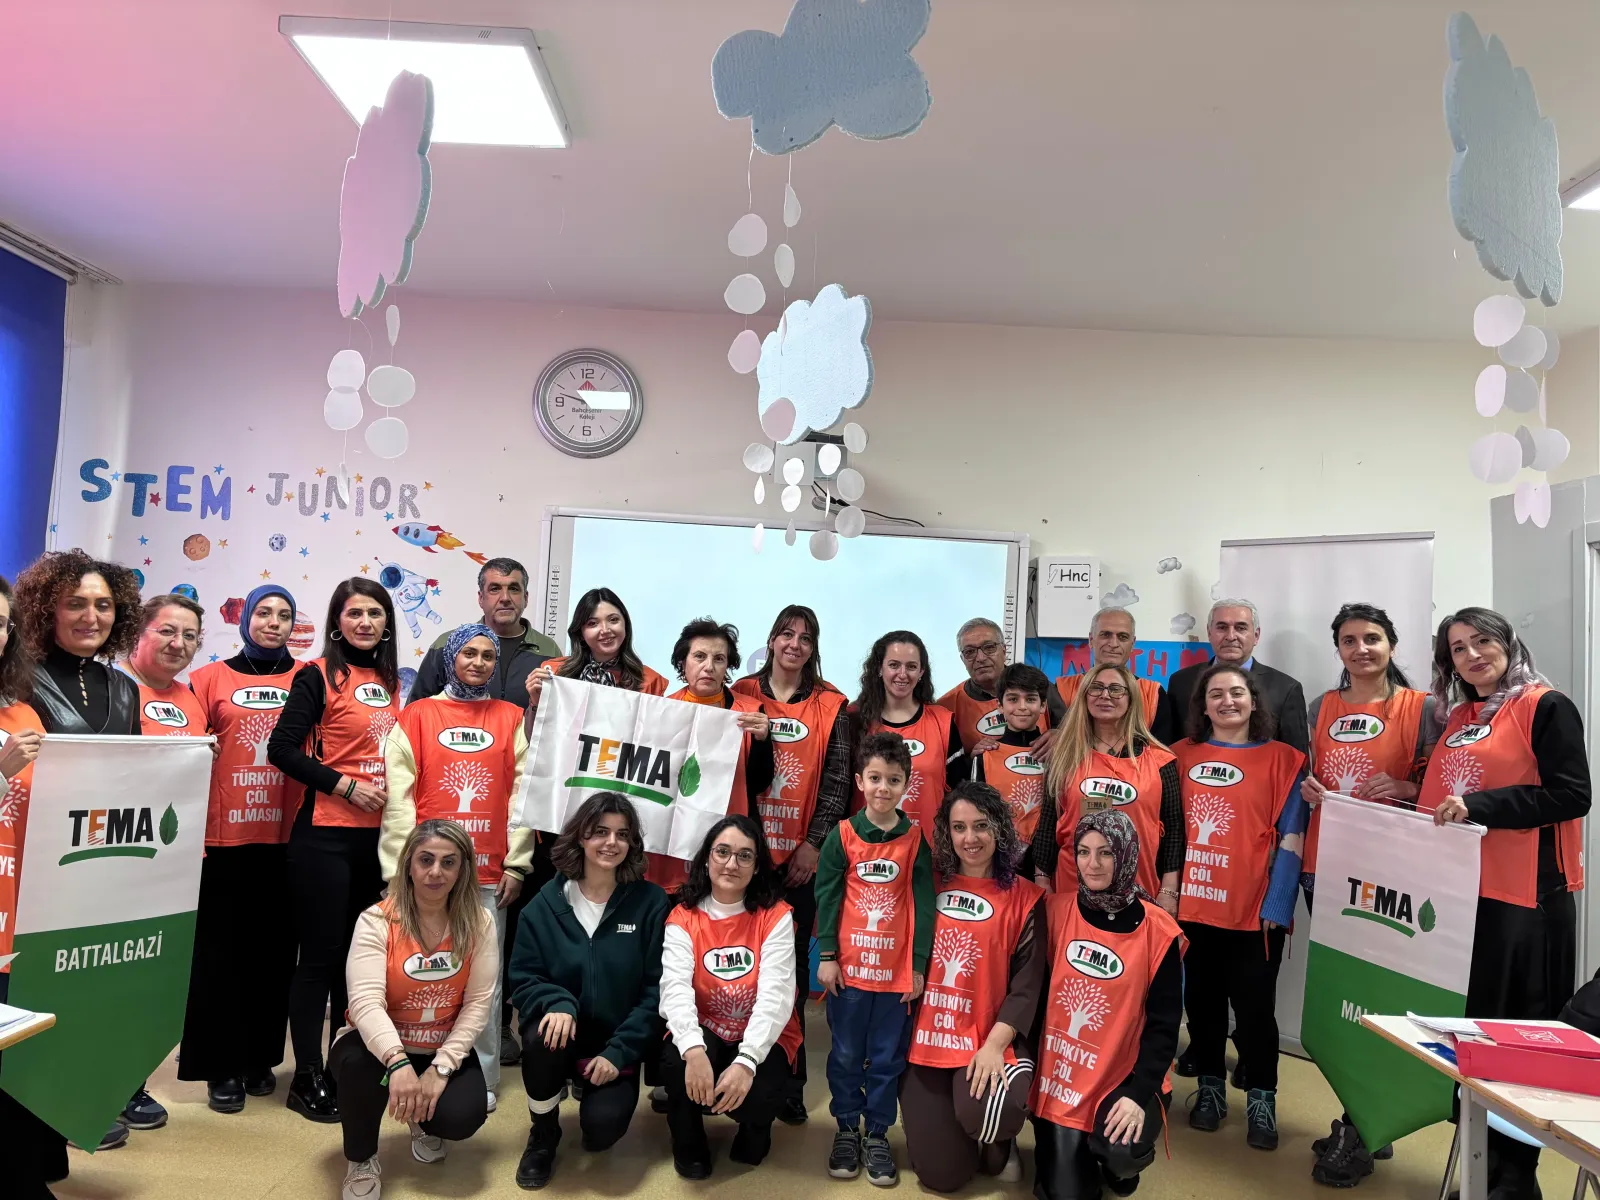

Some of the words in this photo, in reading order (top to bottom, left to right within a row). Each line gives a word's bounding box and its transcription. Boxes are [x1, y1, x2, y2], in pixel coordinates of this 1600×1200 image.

[581, 368, 595, 379] 12
[555, 396, 565, 407] 9
[582, 425, 592, 437] 6
[79, 458, 232, 521] STEM
[1060, 568, 1089, 582] Hnc
[1062, 643, 1168, 677] MTH
[244, 690, 279, 701] TEMA
[362, 687, 384, 698] TEMA
[152, 705, 179, 722] TEMA
[984, 713, 1006, 727] TEM
[769, 721, 794, 733] TEMA
[1339, 718, 1367, 731] TEMA
[449, 731, 478, 743] TEMA
[578, 733, 672, 788] TEMA
[231, 769, 285, 787] TÜRKİYE
[1200, 765, 1227, 778] TEMA
[246, 786, 270, 808] ÇÖL
[1092, 780, 1123, 796] TEMA
[228, 808, 283, 824] OLMASIN
[757, 801, 800, 820] ÜRKİYE
[68, 807, 154, 847] TEMA
[763, 818, 784, 836] ÇÖL
[1185, 845, 1230, 869] ÜRKİYE
[864, 863, 887, 873] TEMA
[1189, 865, 1213, 884] ÇÖL
[946, 894, 976, 911] TEMA
[1180, 883, 1228, 904] LMASIN
[1347, 876, 1413, 924] TEMA
[617, 923, 632, 931] TEMA
[850, 932, 895, 950] TÜRKİYE
[54, 930, 163, 973] BATTALGAZİ
[714, 952, 743, 968] TEMA
[860, 950, 881, 968] ÇÖL
[1077, 944, 1109, 969] TEMA
[417, 956, 448, 969] TEMA
[847, 964, 893, 982] OLMASIN
[923, 987, 972, 1014] TÜRKİYE
[934, 1010, 956, 1031] ÇÖL
[916, 1029, 974, 1051] OLMASIN
[1045, 1033, 1098, 1070] TÜRKİYE
[1052, 1059, 1073, 1083] ÇÖL
